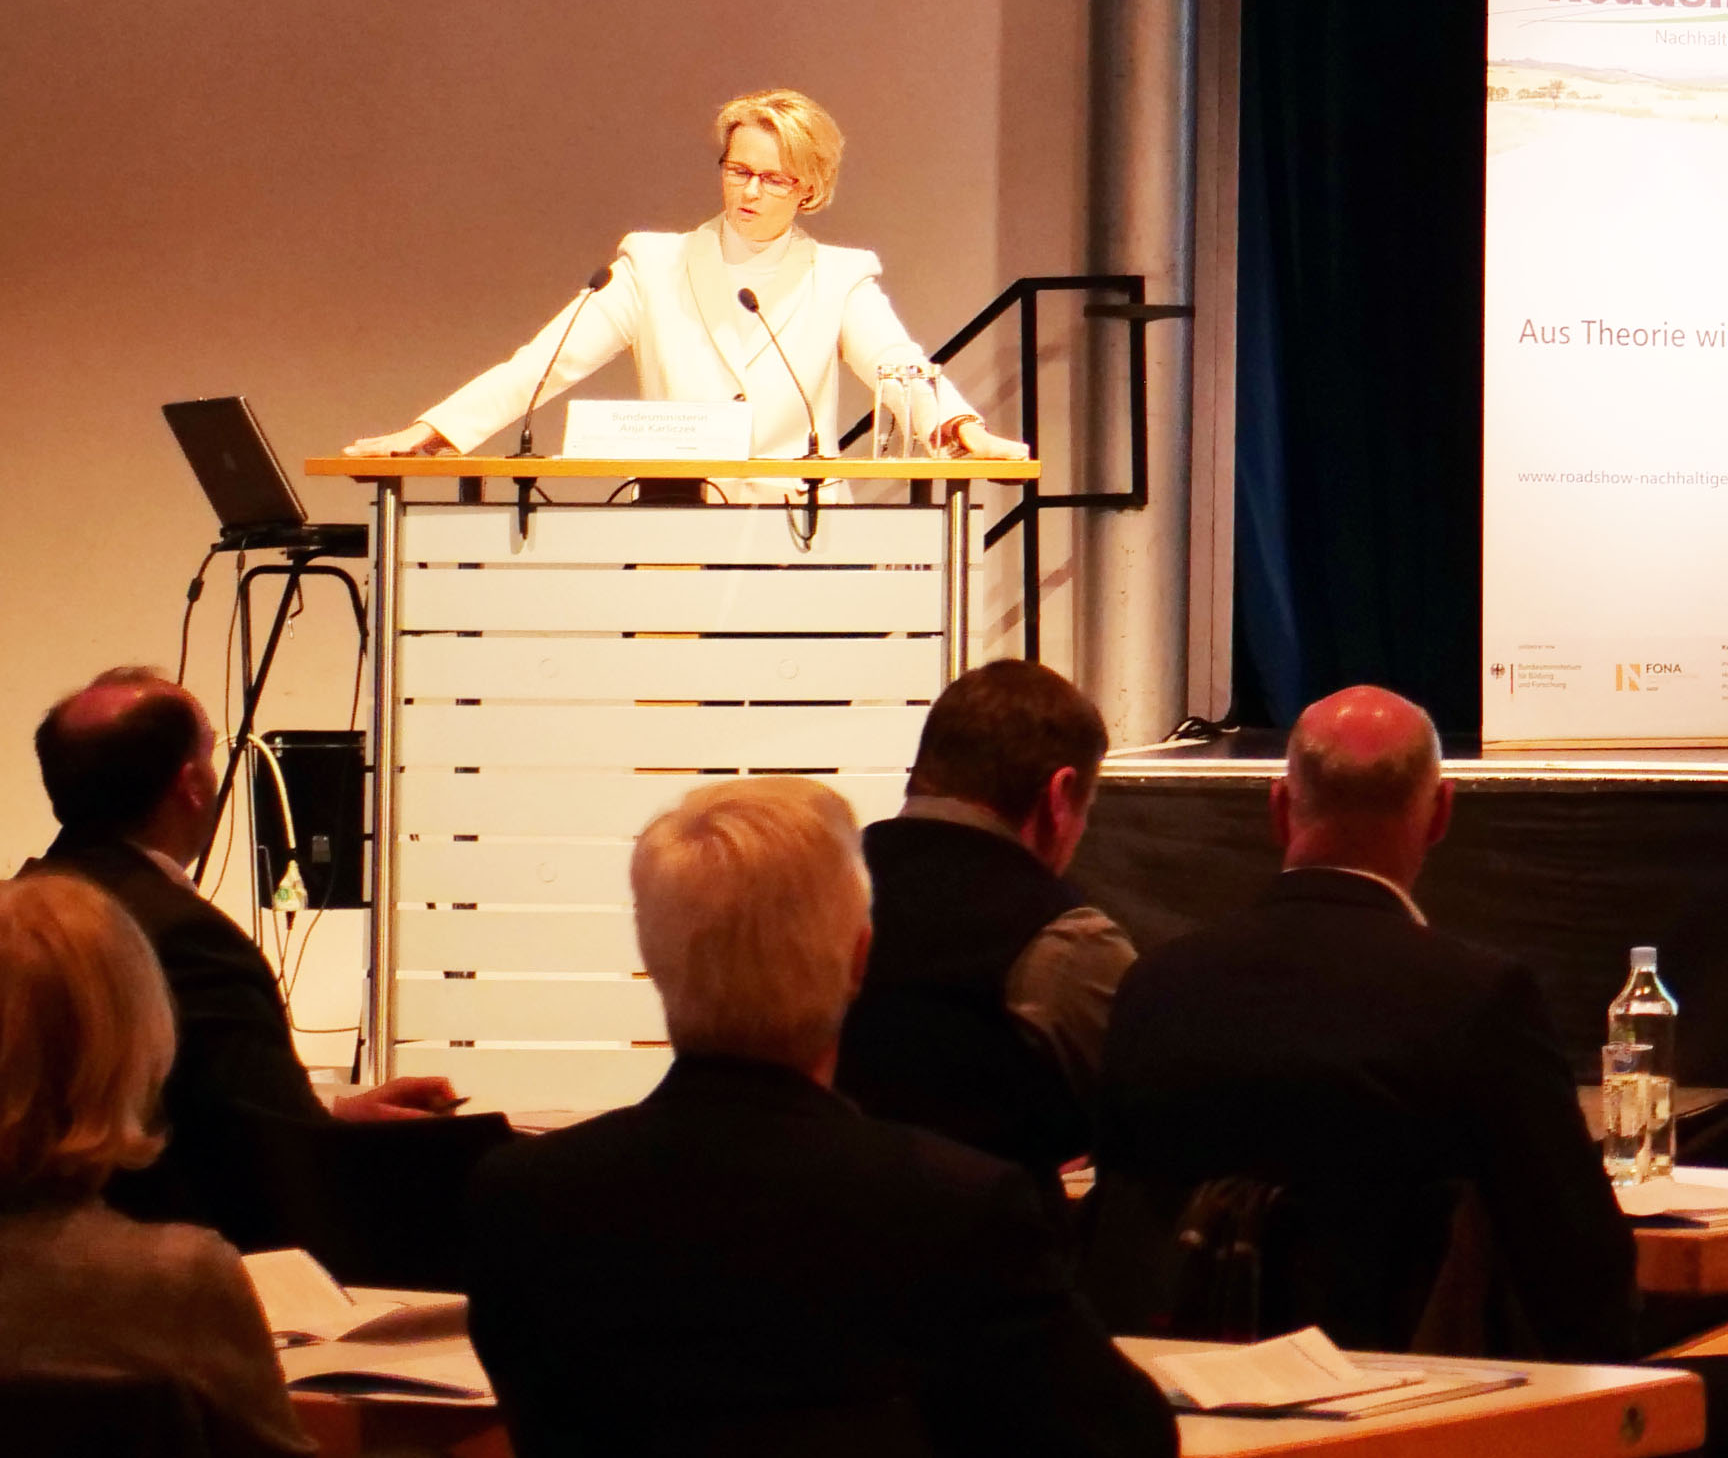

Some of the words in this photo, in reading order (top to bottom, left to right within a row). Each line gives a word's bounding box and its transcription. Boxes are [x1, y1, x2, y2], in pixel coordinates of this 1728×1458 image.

[1518, 318, 1571, 346] Aus
[1581, 319, 1687, 348] Theorie
[1645, 663, 1683, 674] FONA
